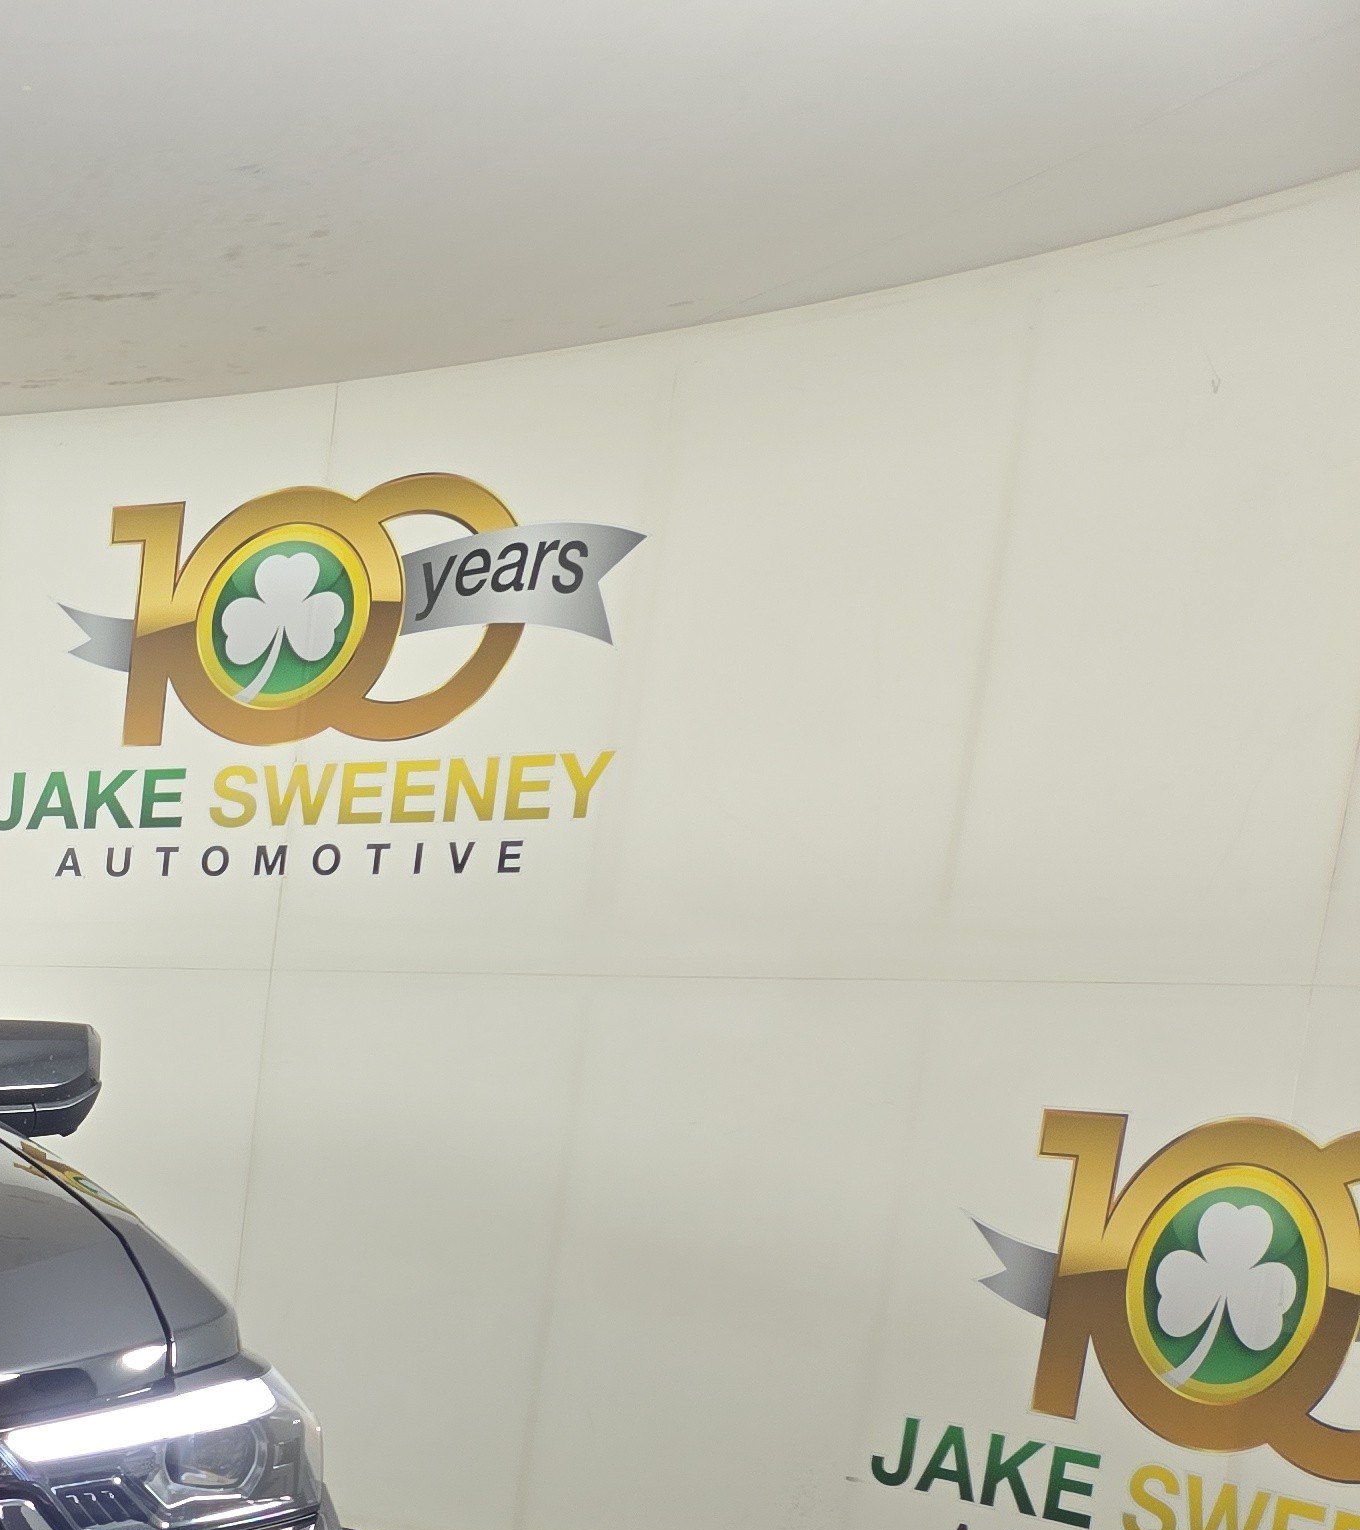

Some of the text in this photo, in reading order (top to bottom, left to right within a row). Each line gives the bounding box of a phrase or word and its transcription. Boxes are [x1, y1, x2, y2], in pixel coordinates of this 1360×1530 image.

[109, 472, 526, 746] 100
[415, 537, 588, 621] years
[209, 750, 616, 828] SWEENEY
[55, 840, 525, 878] AUTOMOTIVE
[871, 1416, 1102, 1530] JAKE
